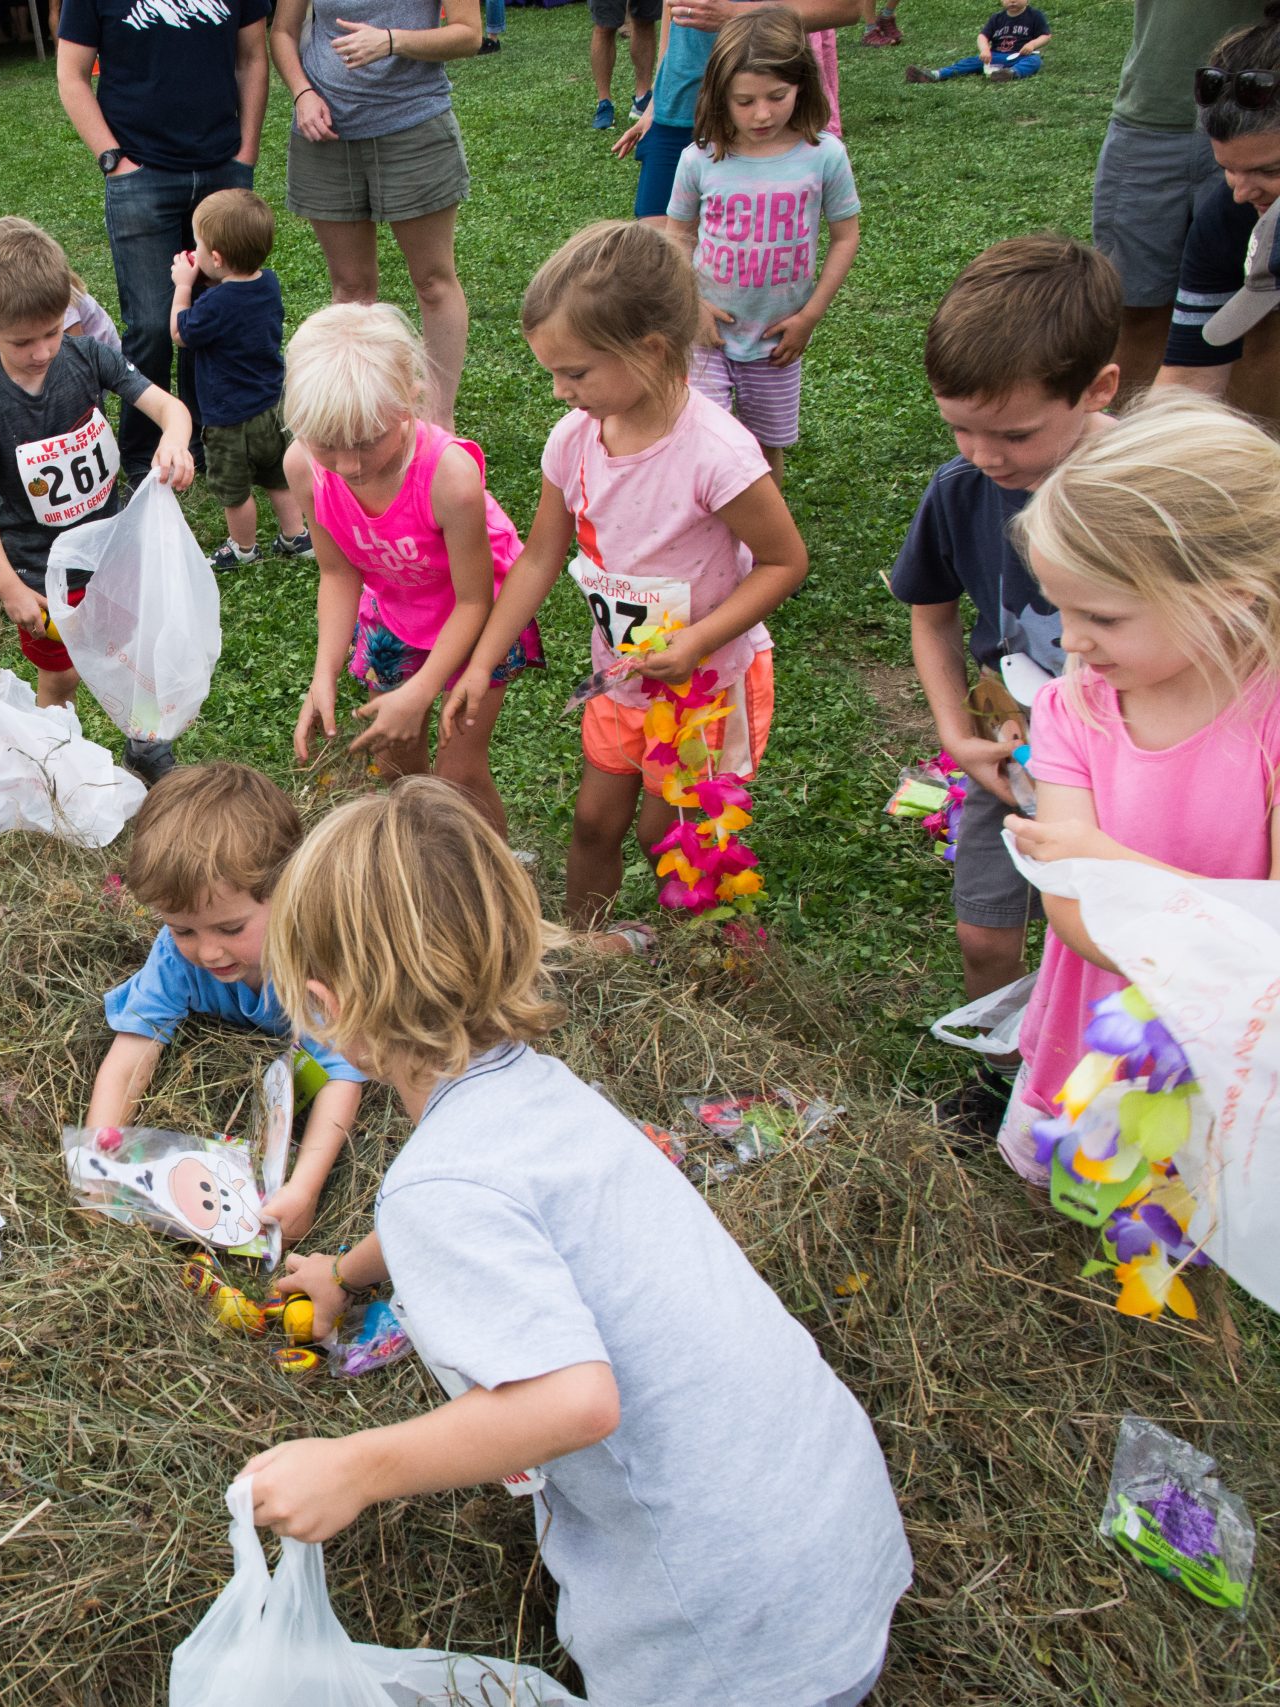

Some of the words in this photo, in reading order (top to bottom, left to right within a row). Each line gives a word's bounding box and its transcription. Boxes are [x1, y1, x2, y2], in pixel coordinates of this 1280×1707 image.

[1012, 25, 1029, 36] SOX
[705, 190, 810, 243] #GIRL
[701, 238, 810, 288] POWER
[26, 451, 60, 466] KIDS
[63, 440, 89, 455] FUN
[90, 421, 106, 441] RUN
[41, 438, 68, 453] VT
[75, 422, 96, 443] 50
[39, 442, 110, 507] 261
[44, 512, 63, 523] OUR
[63, 502, 86, 520] NEXT
[597, 572, 610, 588] VT
[615, 580, 631, 591] 50
[601, 586, 625, 600] FUN
[629, 592, 660, 604] RUN
